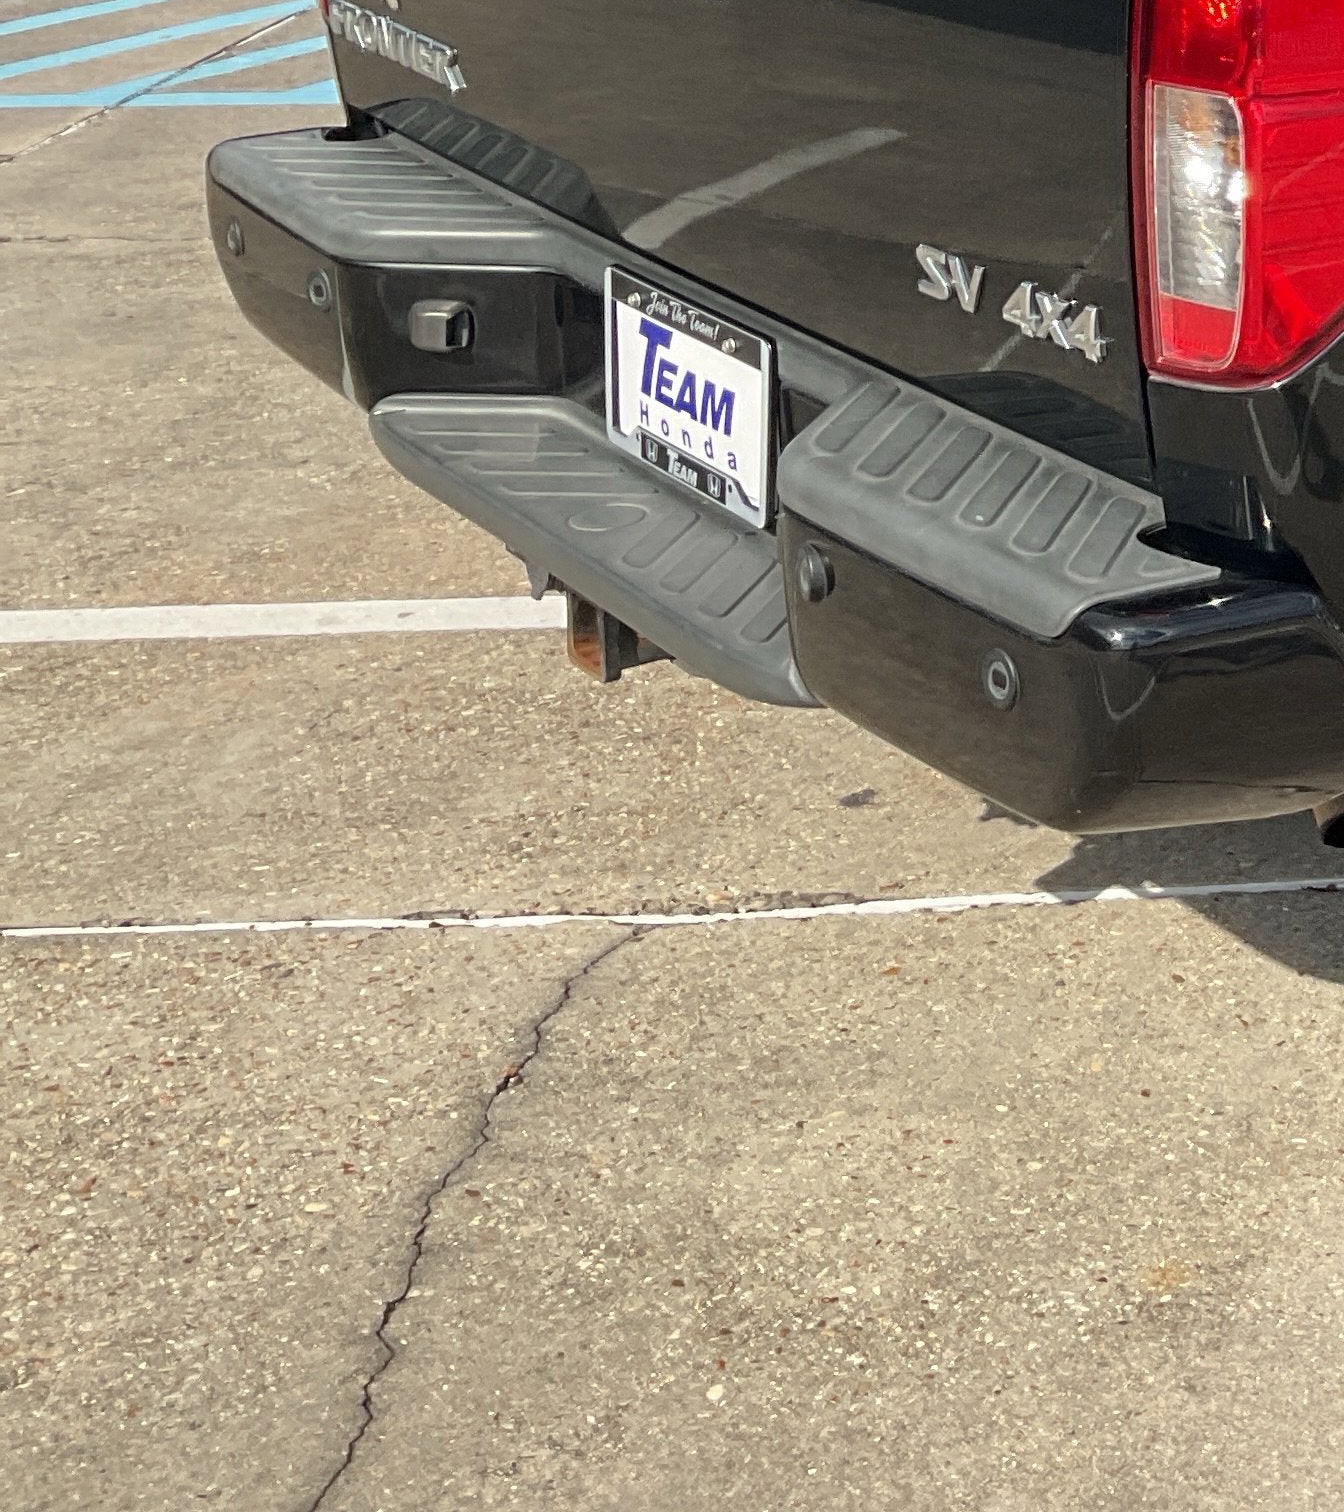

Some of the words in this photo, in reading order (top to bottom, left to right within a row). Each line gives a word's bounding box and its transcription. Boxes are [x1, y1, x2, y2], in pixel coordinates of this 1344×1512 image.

[915, 243, 986, 314] SV
[646, 291, 669, 317] Join
[669, 300, 688, 325] The
[688, 309, 720, 341] Team!
[638, 317, 736, 437] TEAM
[640, 399, 738, 472] Honda
[666, 448, 698, 489] TEAM
